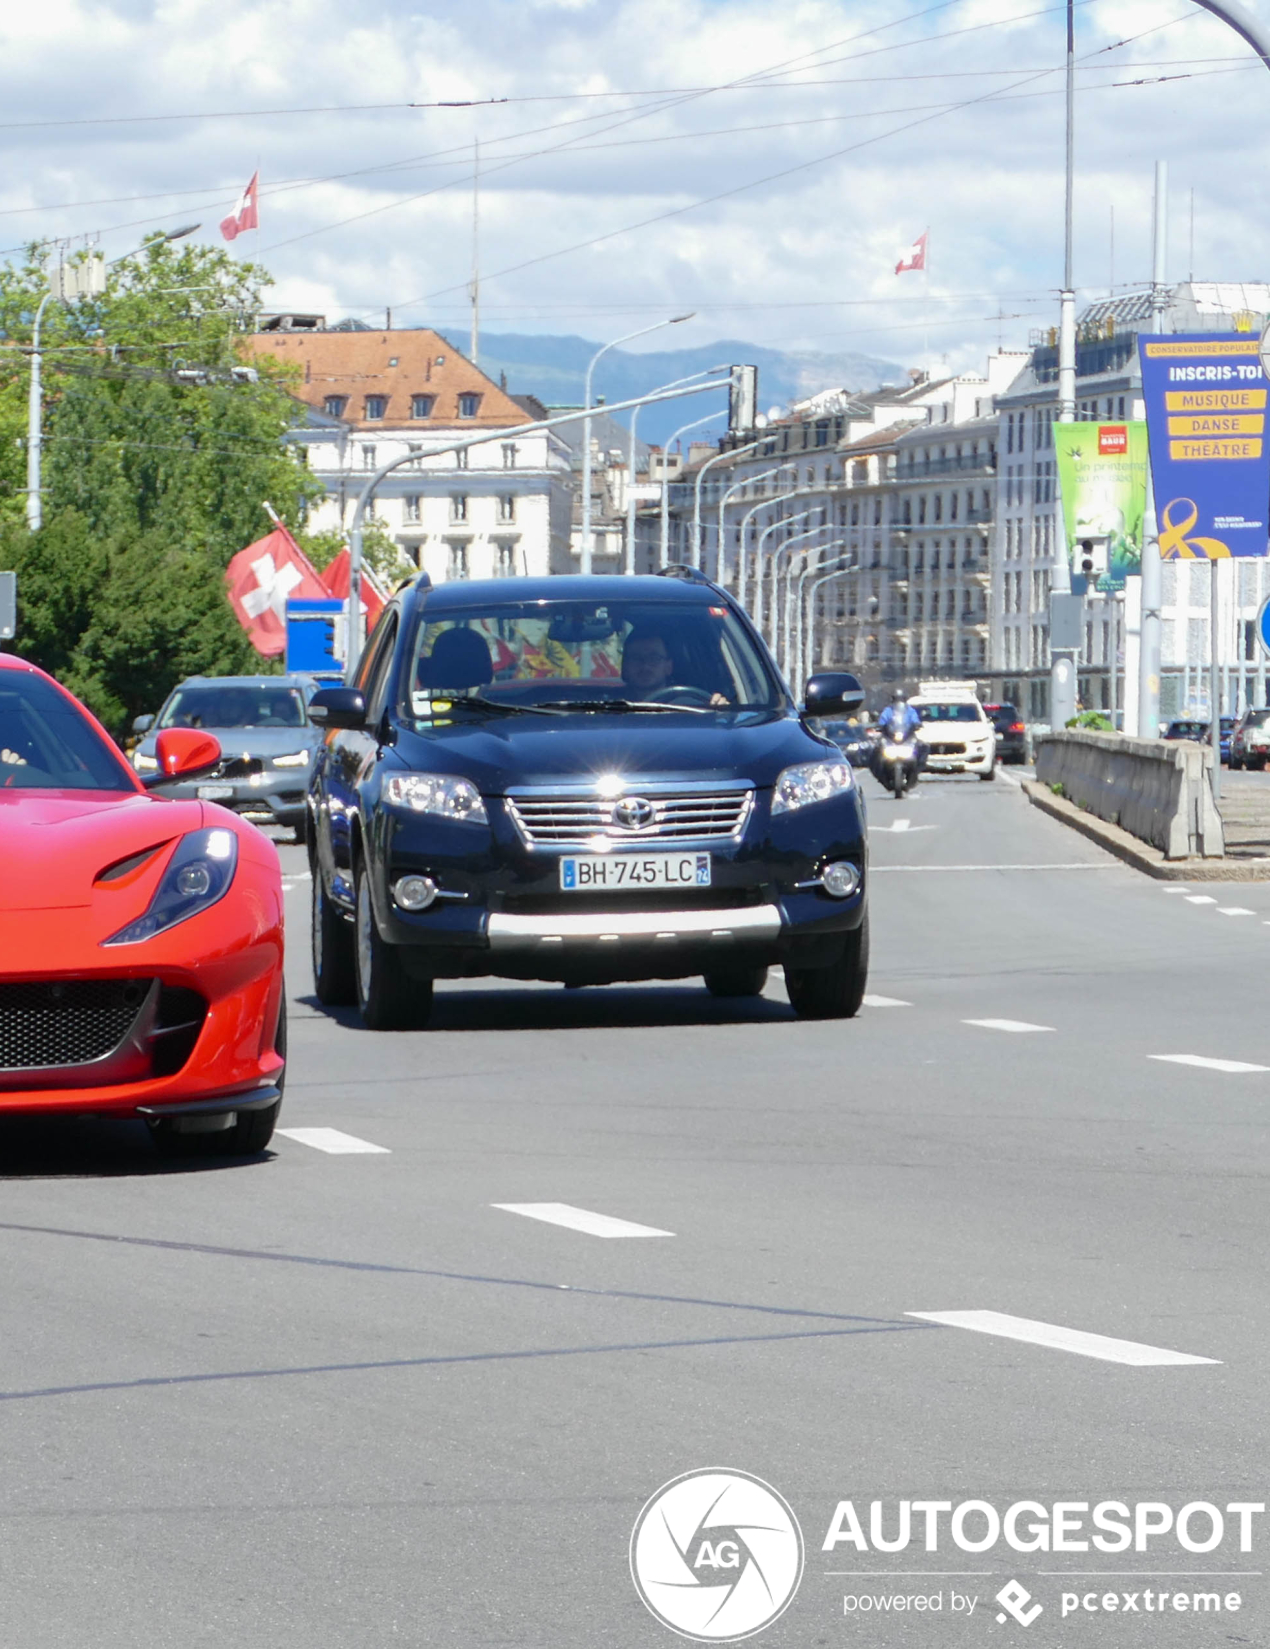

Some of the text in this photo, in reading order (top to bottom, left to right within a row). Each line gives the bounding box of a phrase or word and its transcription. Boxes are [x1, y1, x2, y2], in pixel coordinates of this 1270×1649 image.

[1151, 344, 1260, 354] CONSERVATOIRE POPULAIR
[1170, 366, 1262, 381] INSCRIS-TOI
[1182, 394, 1249, 408] MUSIQUE
[1192, 418, 1240, 431] DANSE
[1182, 441, 1251, 456] THÉÂTRE
[1093, 461, 1147, 472] printemp
[578, 859, 693, 885] BH-745-LC
